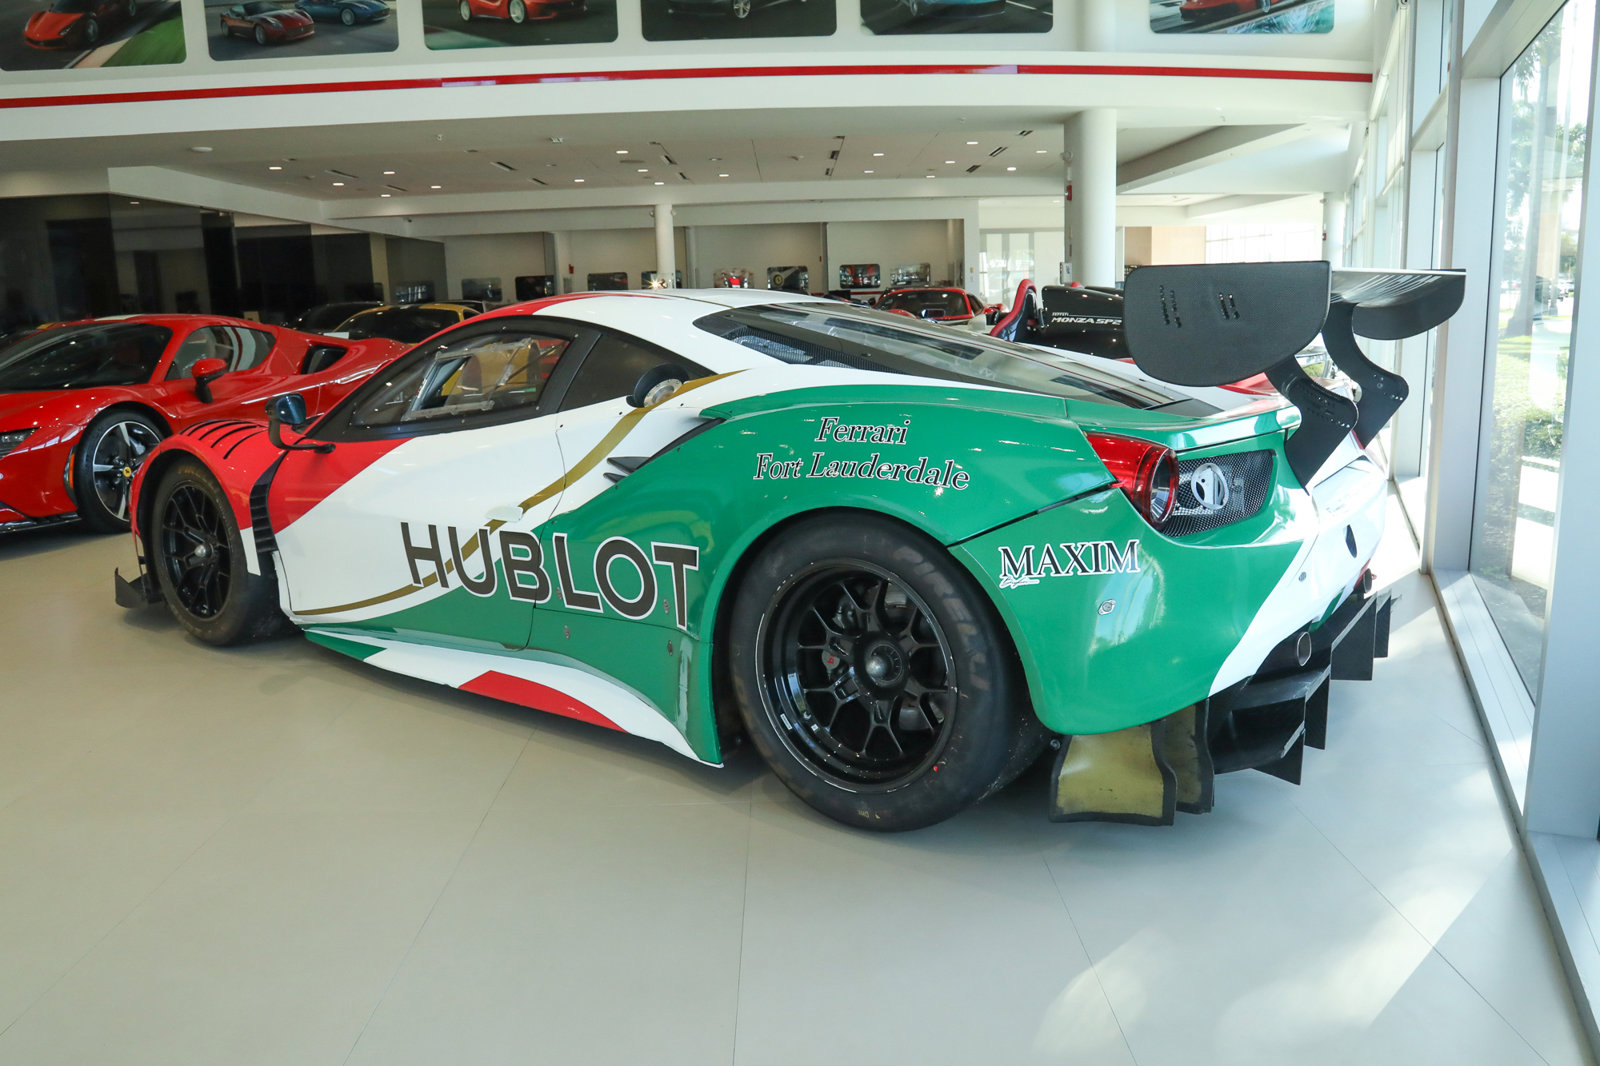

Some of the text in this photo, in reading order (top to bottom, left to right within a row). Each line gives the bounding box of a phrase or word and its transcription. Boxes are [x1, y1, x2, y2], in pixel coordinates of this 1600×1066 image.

[1051, 316, 1123, 326] MONZA SP2
[815, 416, 911, 445] Ferrari
[753, 451, 970, 490] Fort Lauderdale
[400, 521, 699, 631] HUBLOT
[998, 538, 1141, 579] MAXIM
